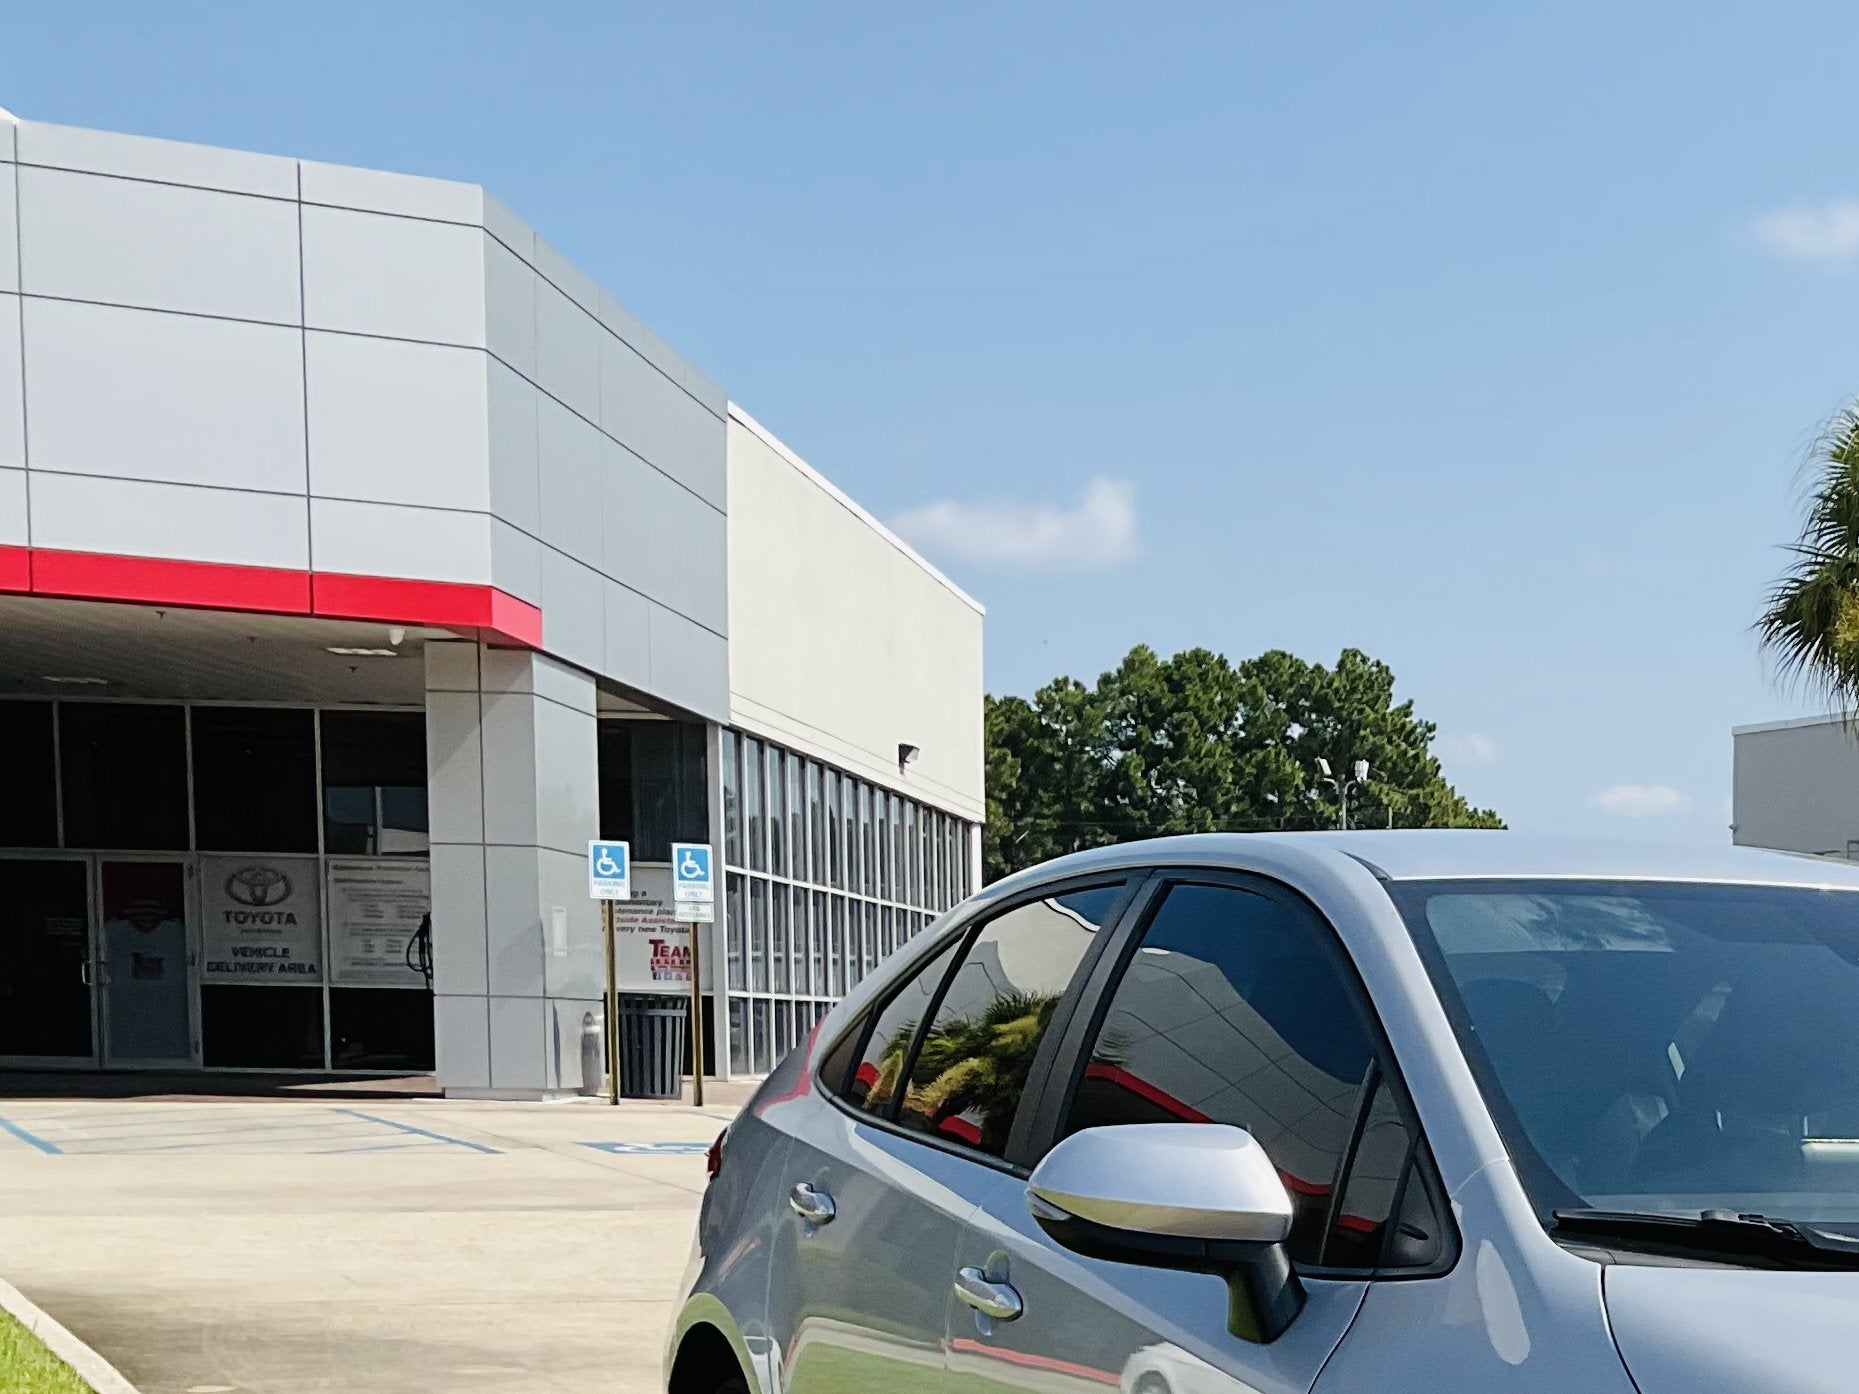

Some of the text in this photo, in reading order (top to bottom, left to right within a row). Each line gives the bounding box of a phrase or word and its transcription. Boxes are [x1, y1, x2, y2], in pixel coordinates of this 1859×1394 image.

[223, 911, 297, 925] TOYOTA
[231, 946, 291, 958] VEHICLE
[278, 963, 317, 974] AREA
